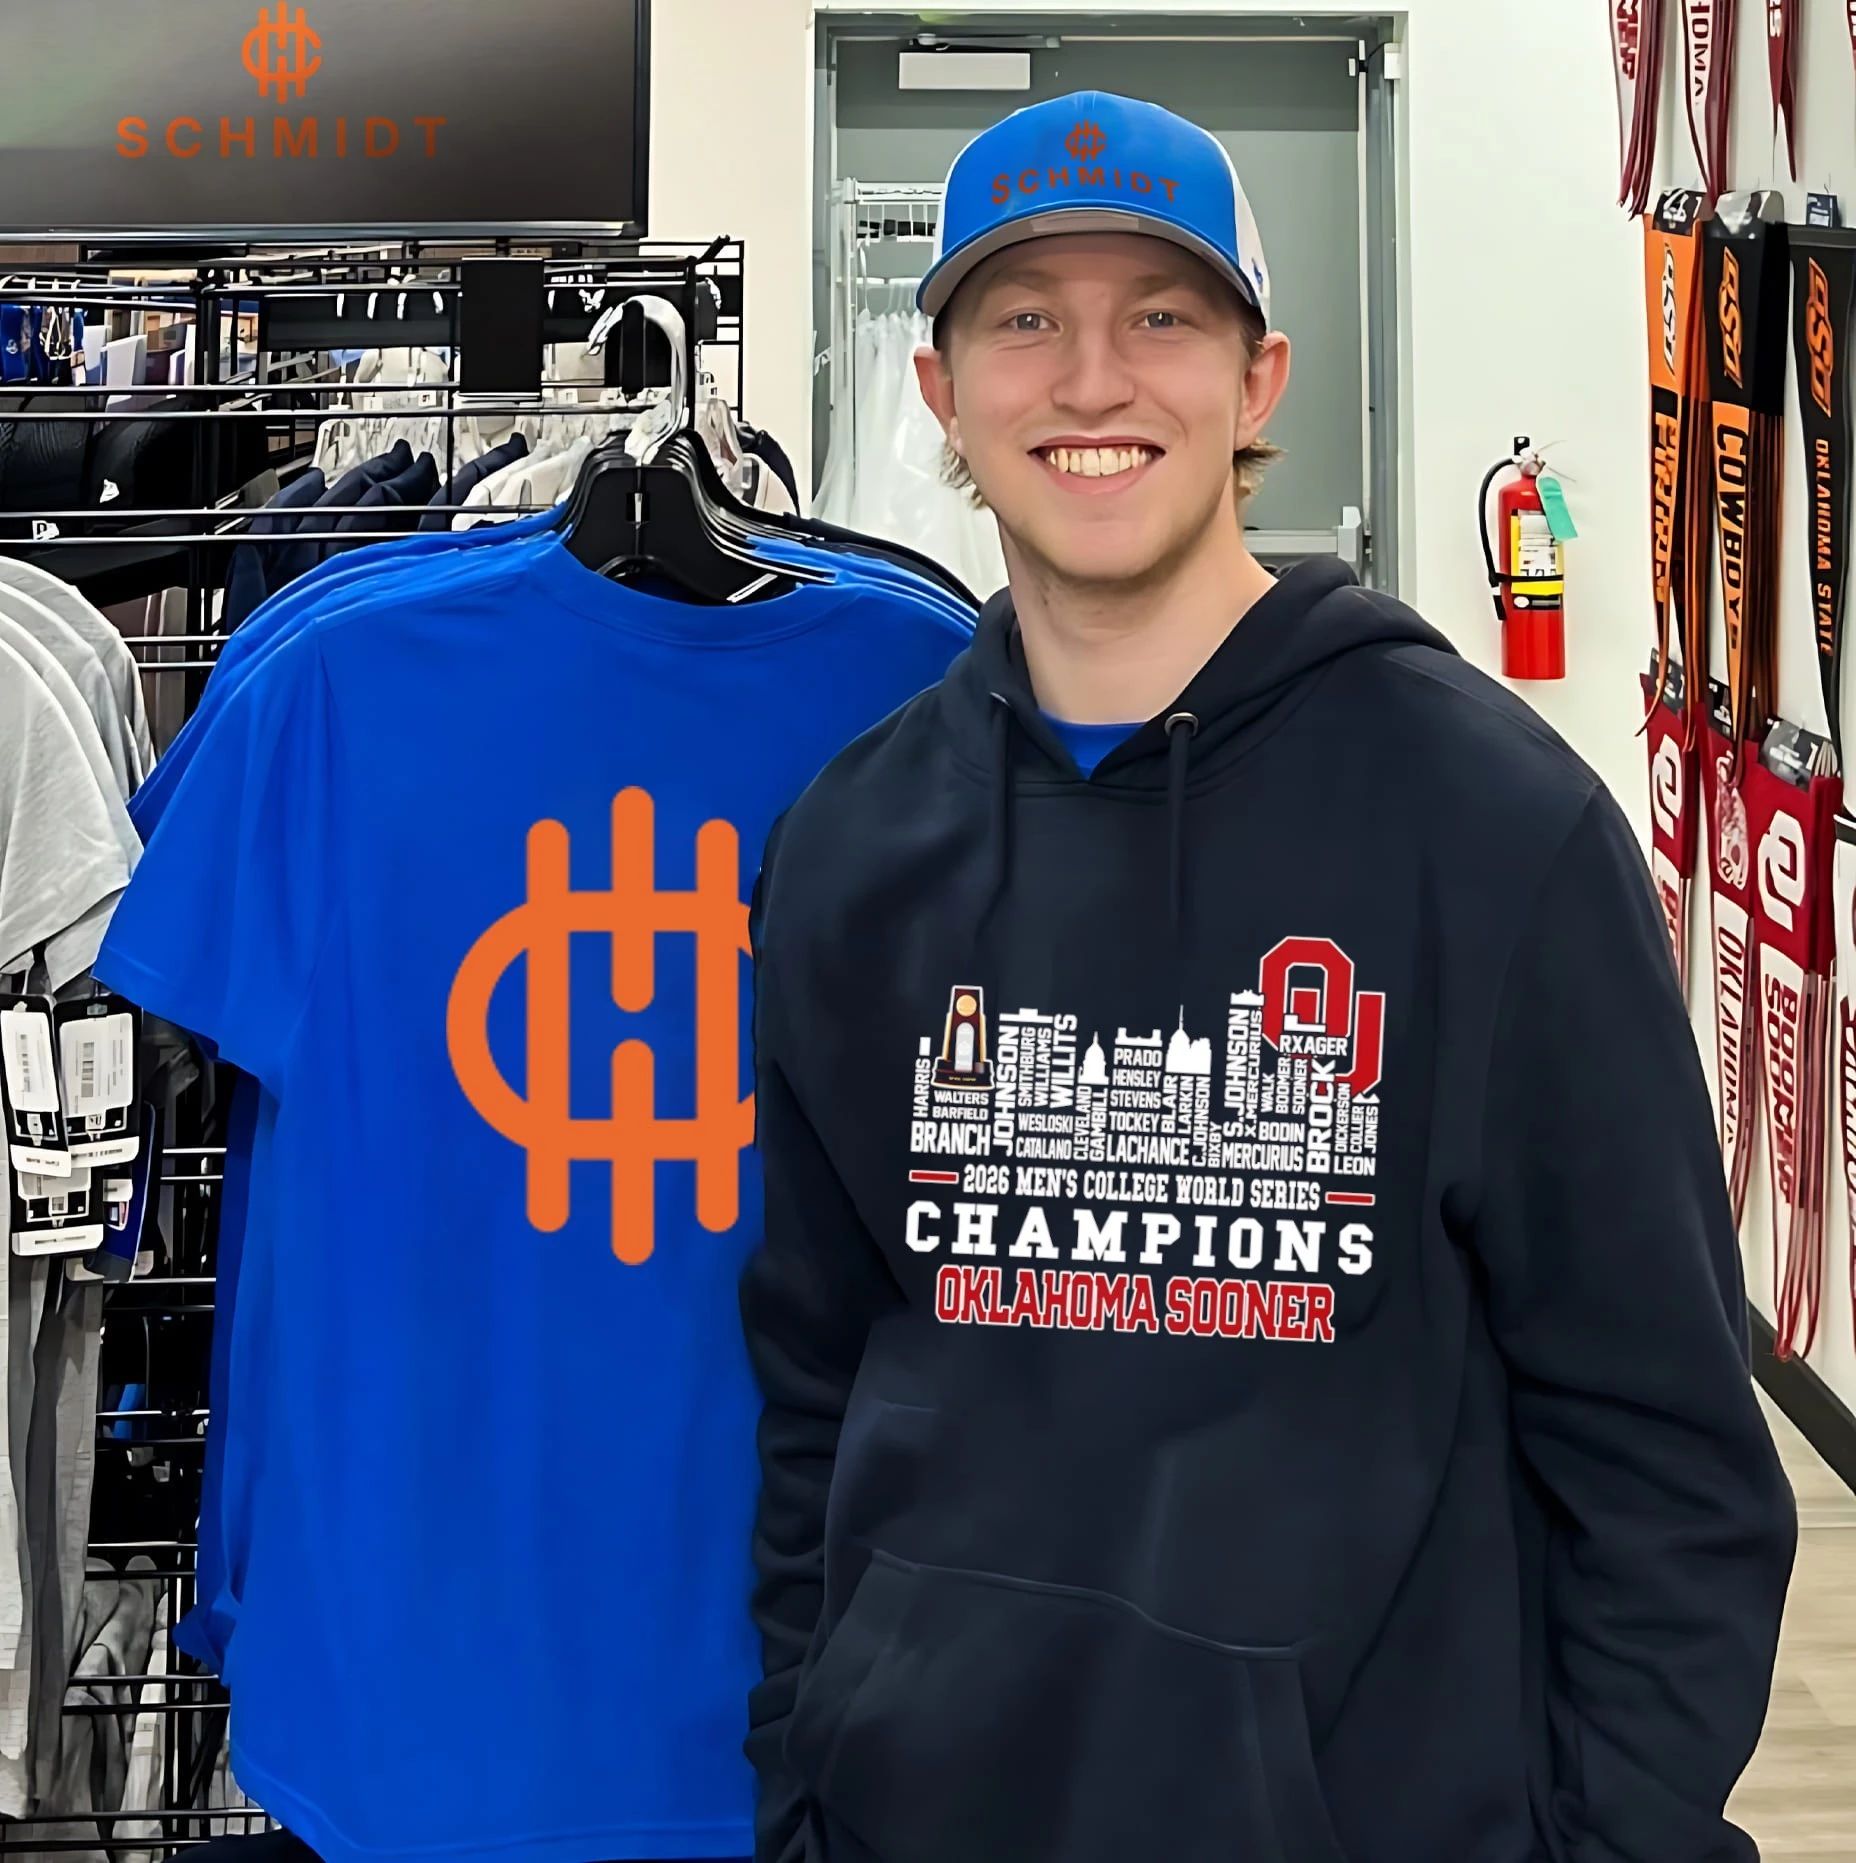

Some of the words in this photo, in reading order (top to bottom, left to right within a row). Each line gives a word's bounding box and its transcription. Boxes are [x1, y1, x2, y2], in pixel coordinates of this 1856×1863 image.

[115, 116, 447, 158] SCHMIDT
[991, 166, 1181, 205] SCHMIDT
[1815, 438, 1832, 570] OKLAHOMA
[1018, 1026, 1036, 1107] SMITHBURG
[1033, 1027, 1052, 1107] WILLIAMS
[1050, 1013, 1078, 1108] WILLITS
[1113, 1048, 1162, 1067] PRADO
[1279, 1035, 1348, 1056] RXAGER
[913, 1058, 931, 1118] HARRIS
[992, 1025, 1019, 1157] JOHNSON
[1112, 1068, 1161, 1088] HENSLEY
[1223, 1008, 1249, 1137] S.JOHNSON
[1260, 1073, 1275, 1113] WALK
[1275, 1056, 1291, 1114] BOOMER
[1292, 1059, 1307, 1115] SOONER
[932, 1106, 989, 1121] BARFIELD
[934, 1090, 989, 1105] WALTERS
[1110, 1089, 1161, 1109] STEVENS
[1160, 1075, 1178, 1133] BLAIR
[1177, 1076, 1194, 1134] LARKIN
[1191, 1076, 1211, 1167] C.JOHNSON
[1306, 1060, 1336, 1173] BROCK
[1335, 1082, 1351, 1153] DICKERSON
[910, 1121, 991, 1156] BRANCH
[1018, 1113, 1073, 1133] WESLOSKI
[1073, 1086, 1092, 1161] CLEVELAND
[1089, 1088, 1108, 1162] GAMBILL
[1109, 1111, 1160, 1133] TOCKEY
[1207, 1121, 1222, 1168] BIXBY
[1259, 1121, 1305, 1142] BODIN
[1350, 1106, 1364, 1154] COLLIER
[1364, 1105, 1379, 1154] JONES
[1016, 1136, 1072, 1160] CATALANO
[1106, 1134, 1190, 1166] LACHANCE
[1221, 1142, 1304, 1172] MERCURIUS
[1333, 1156, 1376, 1176] LEON
[963, 1164, 1009, 1194] 2026
[1015, 1168, 1078, 1198] MEN'S
[1083, 1171, 1170, 1202] COLLEGE
[1176, 1175, 1243, 1207] WORLD
[1249, 1180, 1321, 1211] SERIES
[905, 1200, 1374, 1275] CHAMPIONS
[935, 1264, 1159, 1334] OKLAHOMA
[1165, 1276, 1335, 1342] SOONER
